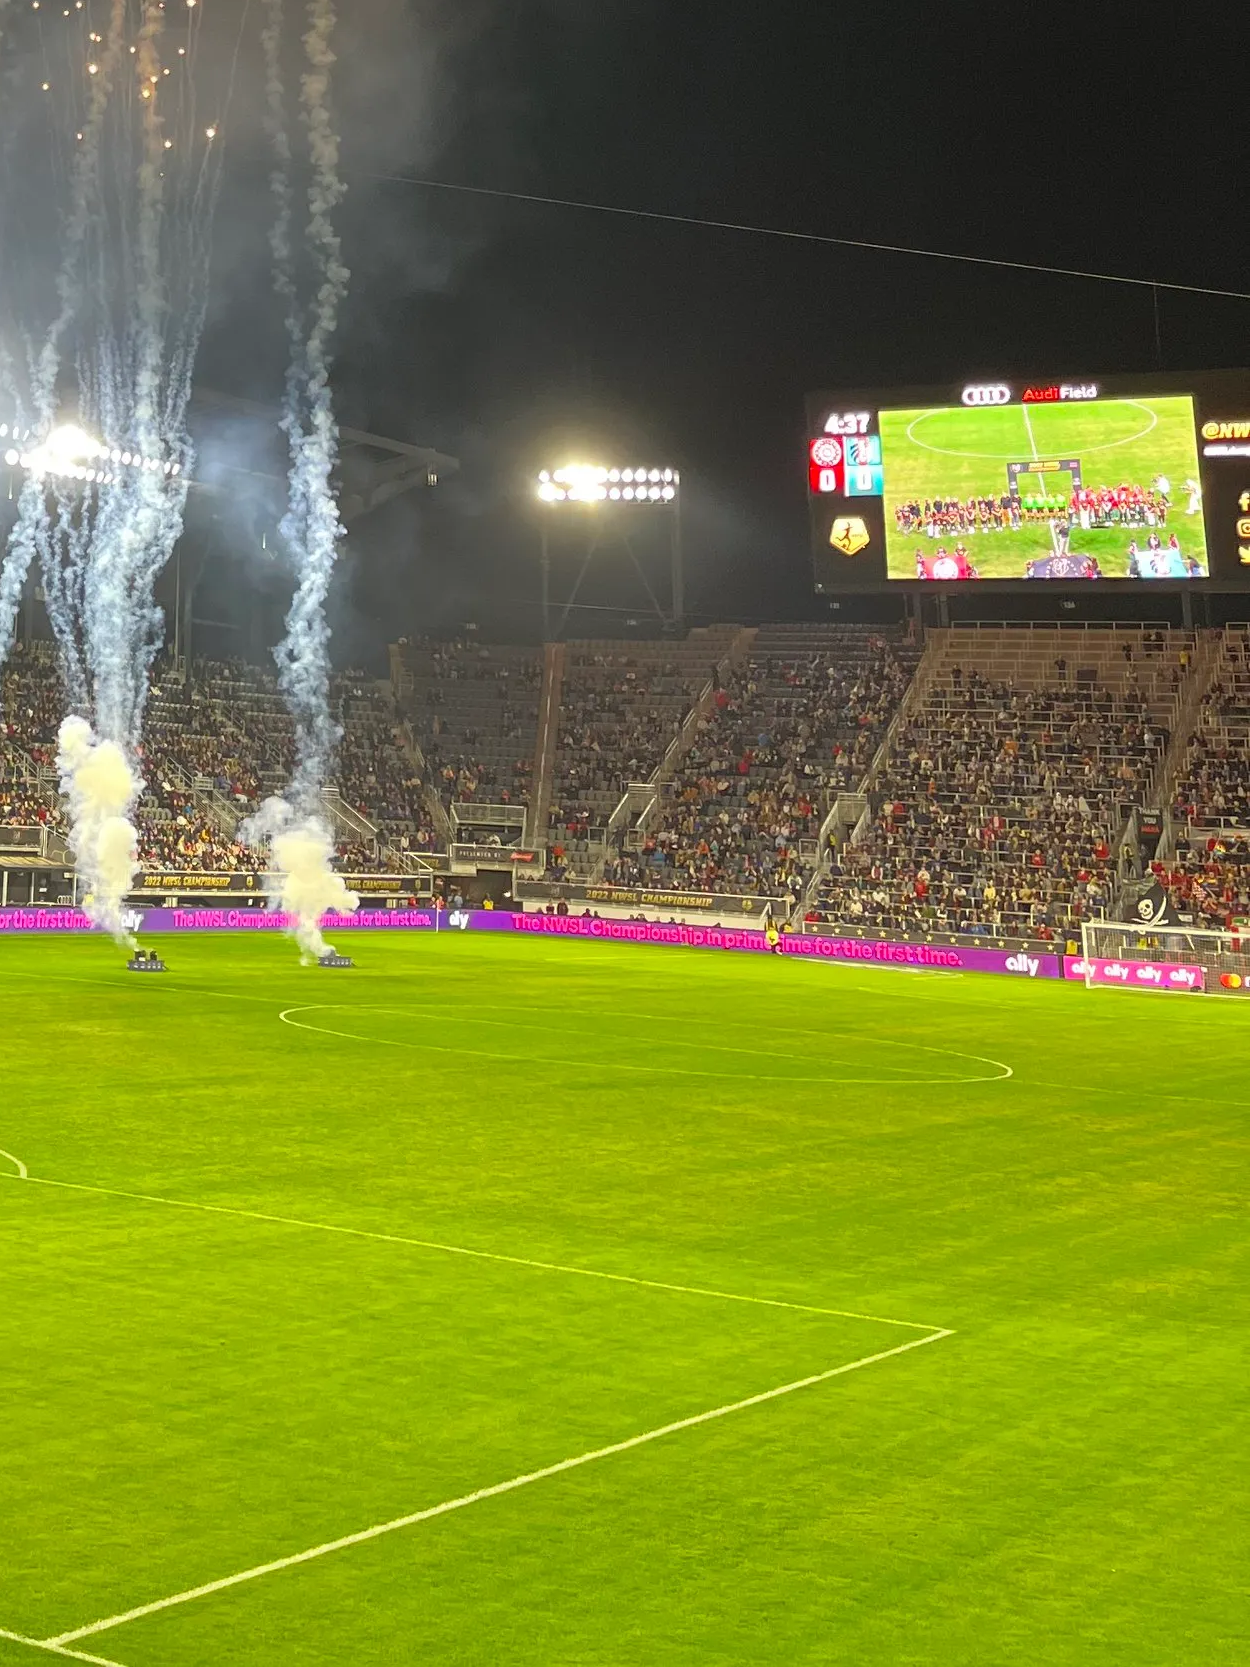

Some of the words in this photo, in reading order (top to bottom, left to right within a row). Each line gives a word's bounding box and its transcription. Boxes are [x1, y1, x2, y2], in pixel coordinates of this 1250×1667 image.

[1023, 388, 1059, 402] Audi
[1060, 385, 1098, 400] Field
[825, 414, 870, 434] 4:37
[1202, 421, 1250, 439] @NW
[819, 469, 836, 492] 0
[857, 467, 873, 491] 0
[144, 876, 162, 886] 2022
[586, 889, 608, 900] 2022
[611, 891, 637, 902] NWSL
[641, 891, 713, 907] CHAMPIONSHIP
[13, 909, 35, 929] the
[36, 909, 63, 929] first
[121, 910, 143, 931] ally
[173, 910, 194, 927] The
[195, 910, 226, 927] NWSL
[360, 910, 373, 926] for
[374, 910, 390, 926] the
[390, 910, 409, 926] first
[410, 910, 431, 926] time.
[512, 913, 541, 931] The
[542, 917, 589, 935] NWSL
[590, 920, 704, 946] Championship
[706, 927, 724, 947] in
[814, 936, 843, 956] for
[844, 938, 872, 958] the
[875, 942, 914, 962] first
[916, 946, 963, 965] time.
[1005, 953, 1040, 977] ally
[1104, 963, 1129, 979] ally
[1136, 965, 1162, 983] ally
[1170, 968, 1196, 985] ally
